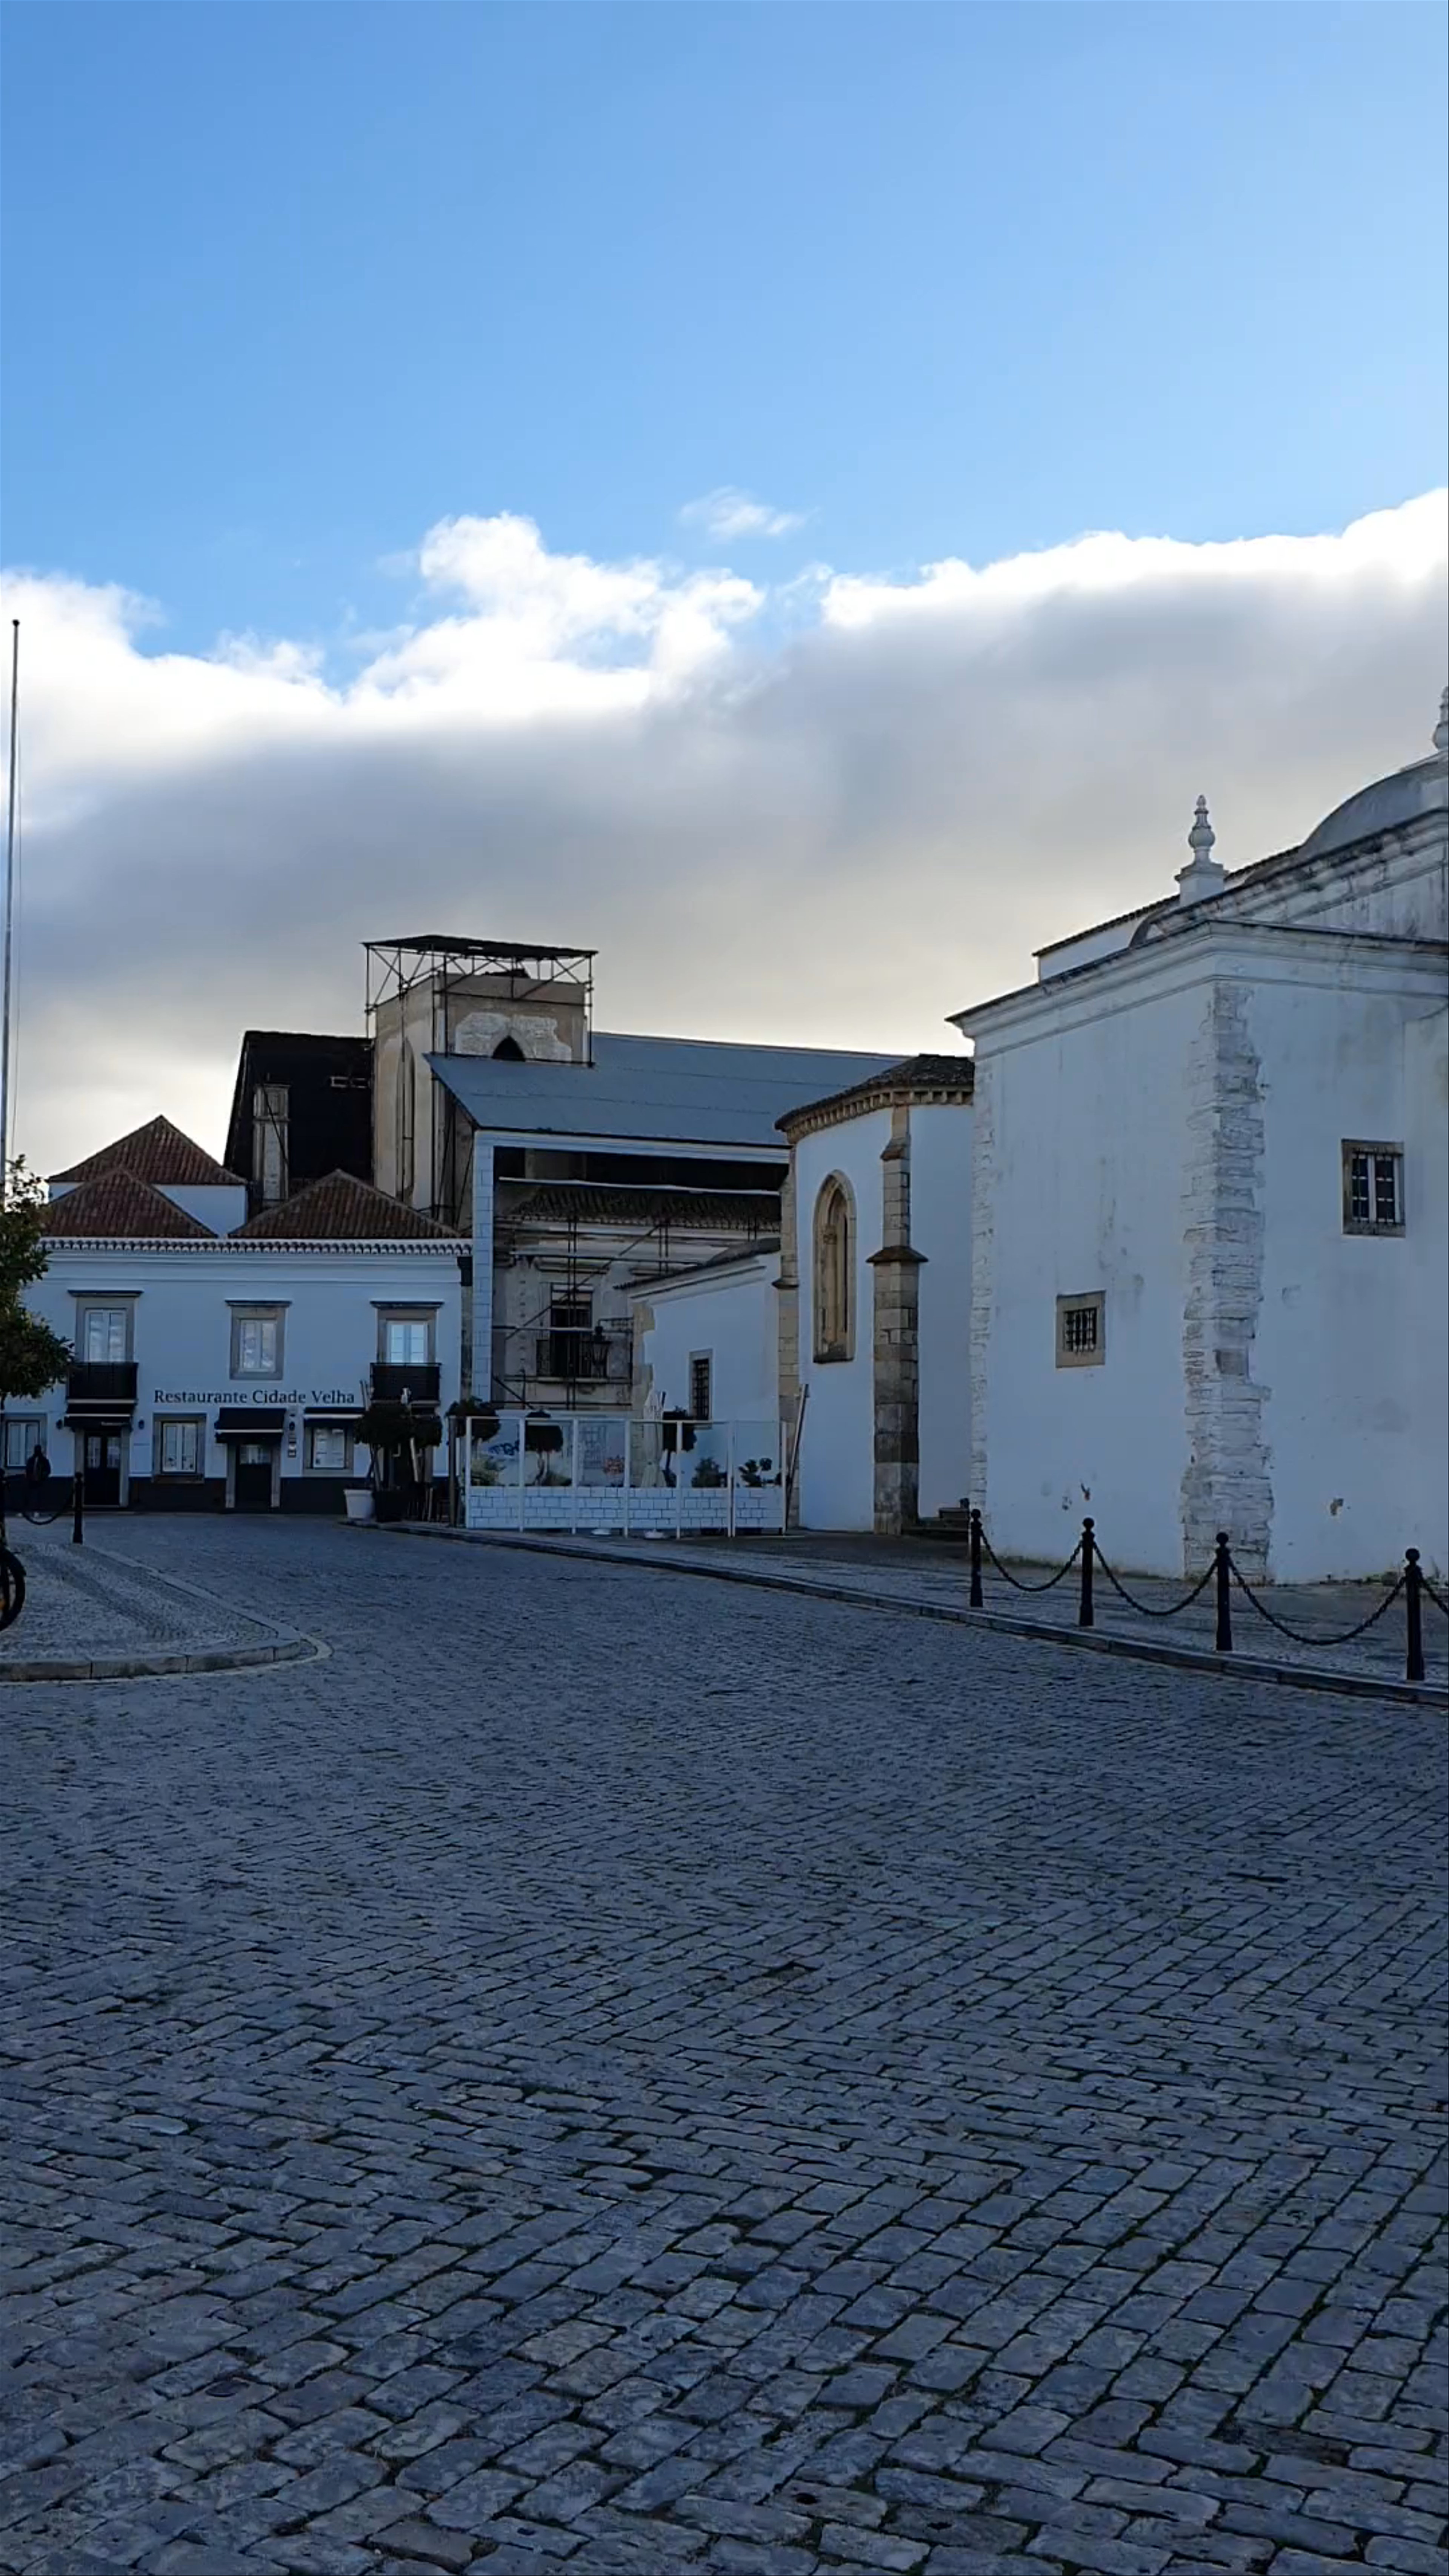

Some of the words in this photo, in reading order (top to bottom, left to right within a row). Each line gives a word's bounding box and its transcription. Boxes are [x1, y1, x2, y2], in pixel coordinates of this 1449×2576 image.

[154, 1389, 247, 1403] Restaurante
[252, 1389, 306, 1403] Cidade
[312, 1389, 354, 1403] Velha
